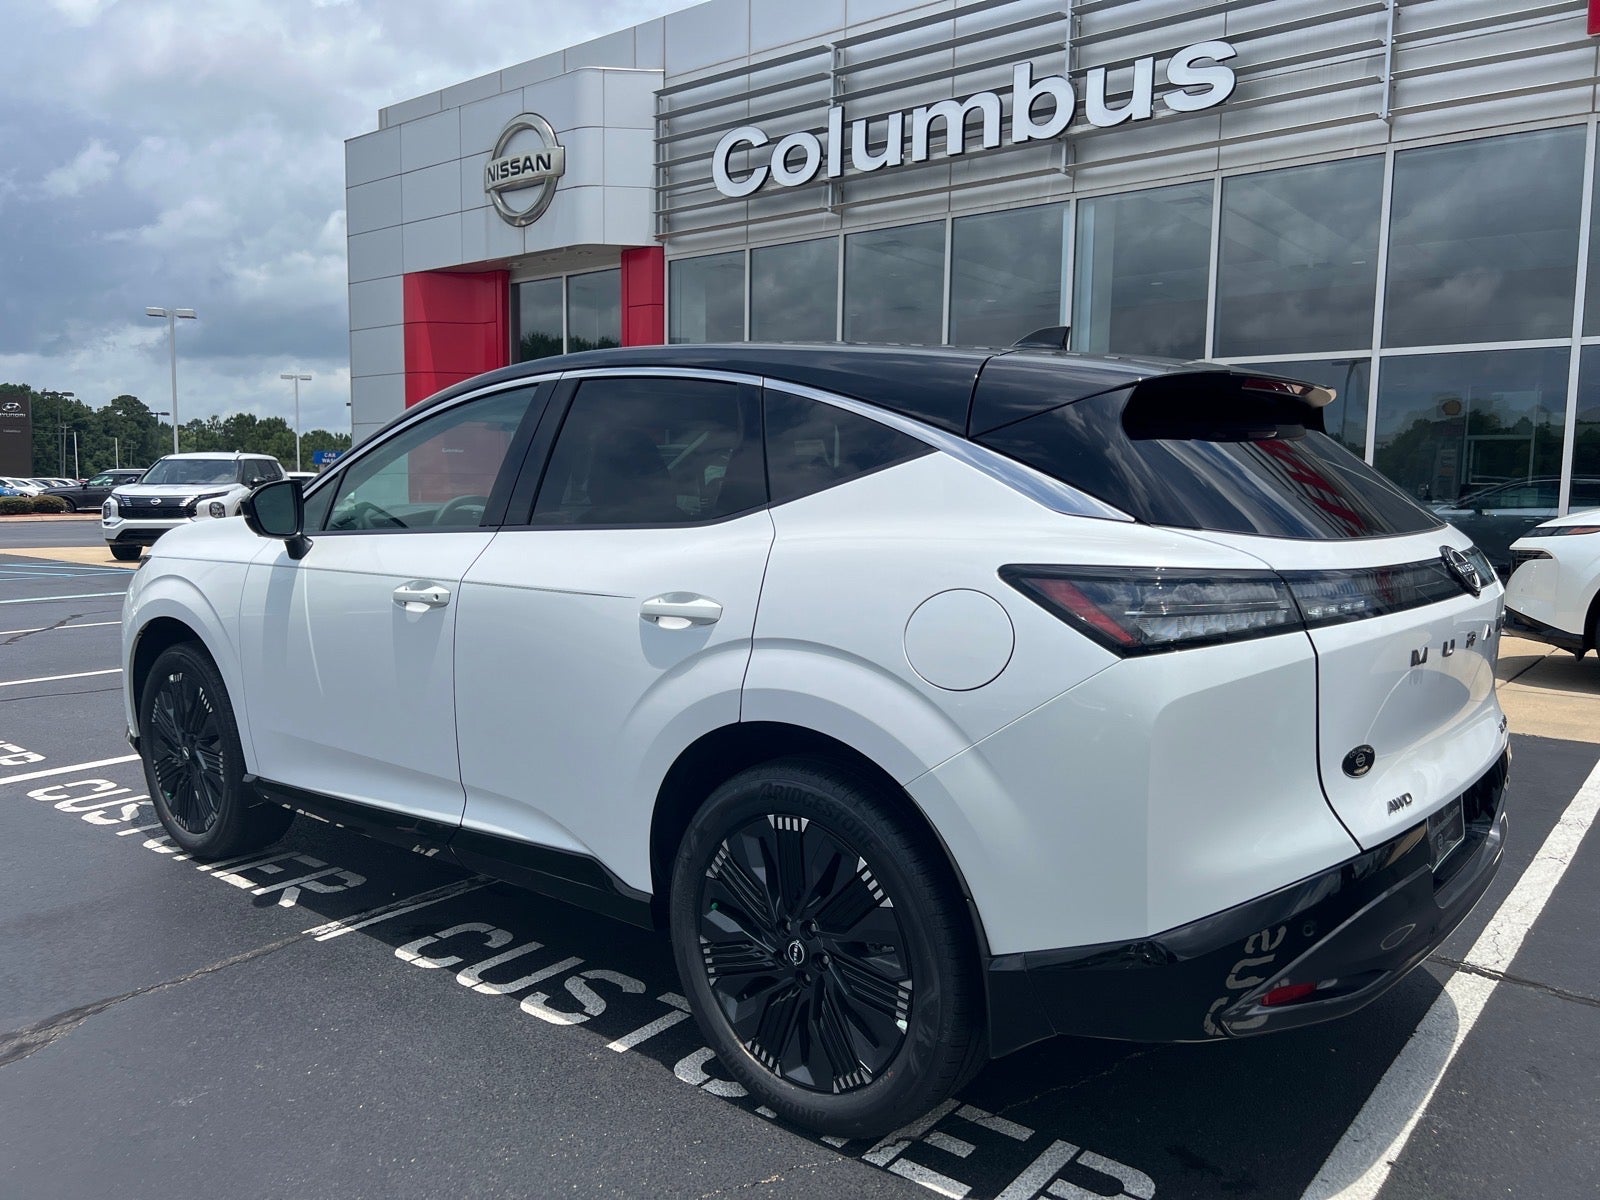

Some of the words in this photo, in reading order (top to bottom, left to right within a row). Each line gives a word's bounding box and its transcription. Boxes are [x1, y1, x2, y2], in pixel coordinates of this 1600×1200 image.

[712, 40, 1238, 198] Columbus
[487, 153, 552, 184] NISSAN
[1387, 792, 1412, 816] AWD
